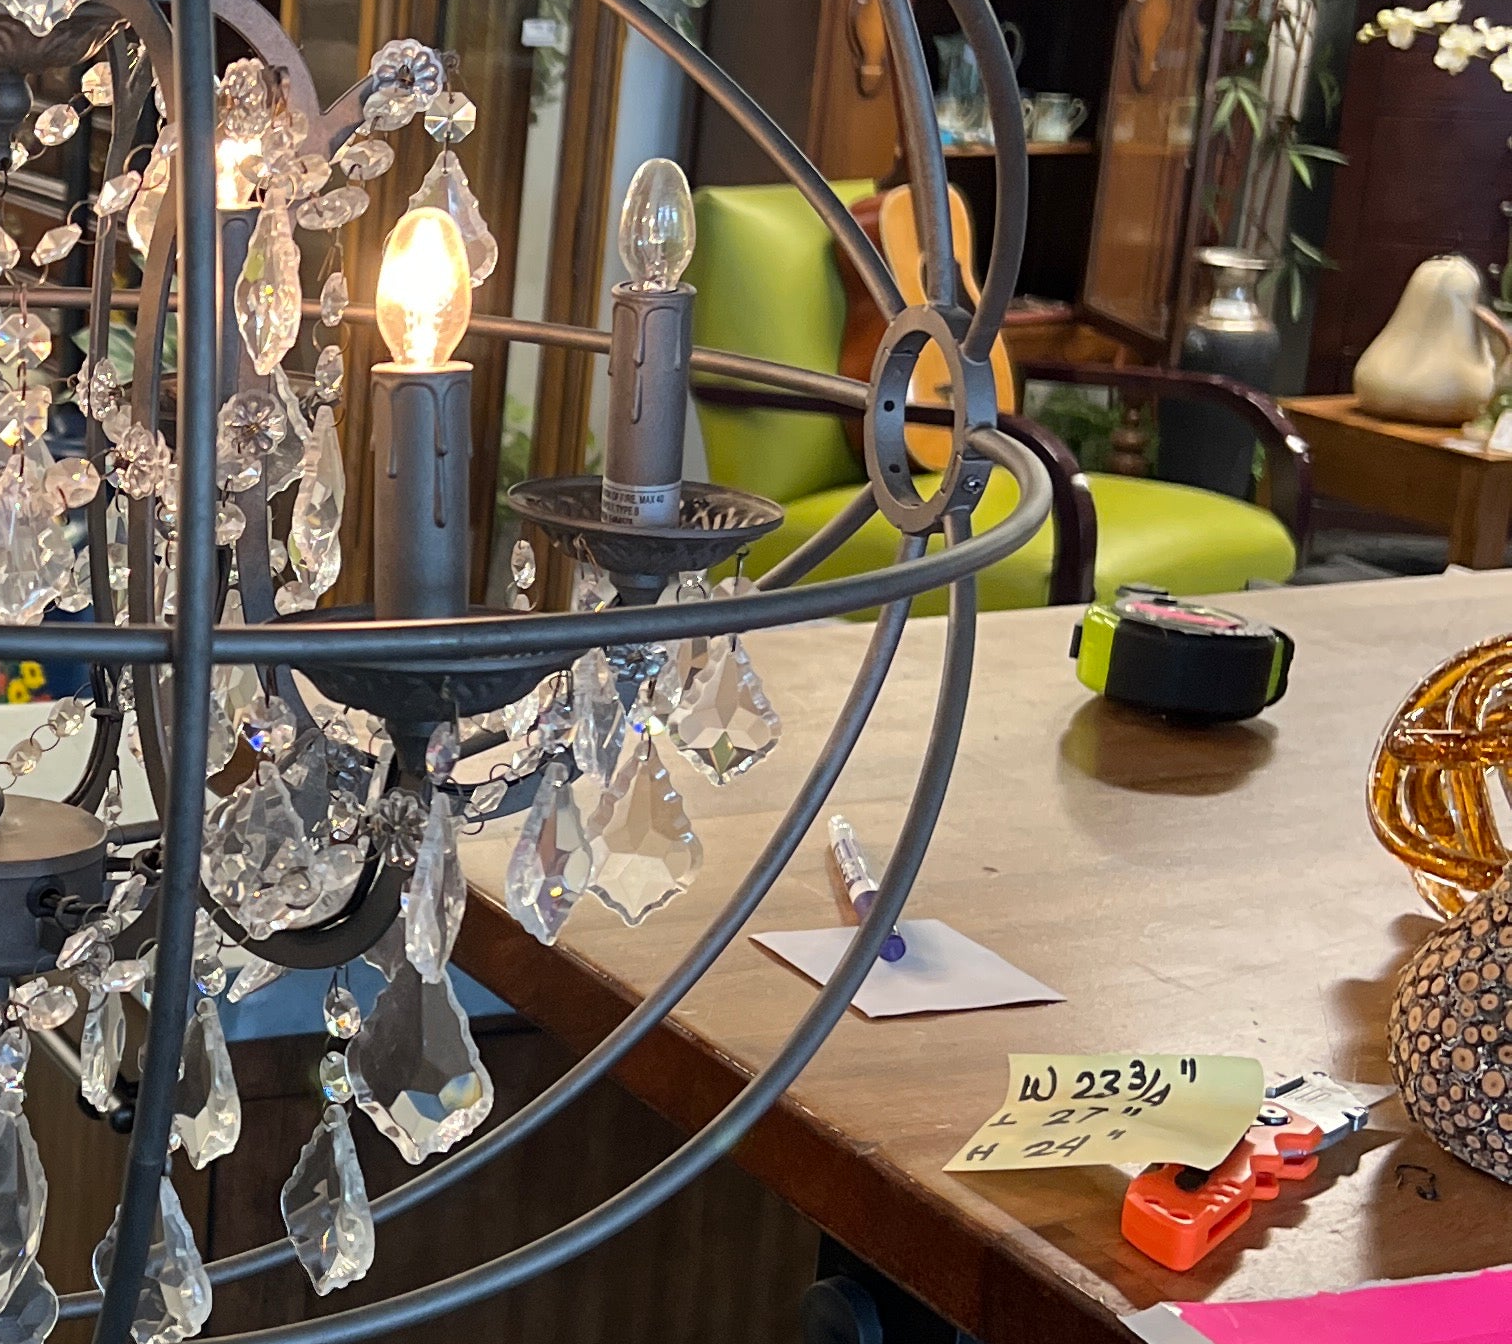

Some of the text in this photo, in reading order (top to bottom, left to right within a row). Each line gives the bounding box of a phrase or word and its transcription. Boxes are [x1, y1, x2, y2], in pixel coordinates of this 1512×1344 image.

[639, 495, 655, 504] MAX
[616, 504, 633, 516] TYPE
[1018, 1065, 1057, 1102] W
[1070, 1069, 1121, 1100] 23
[966, 1142, 999, 1162] H
